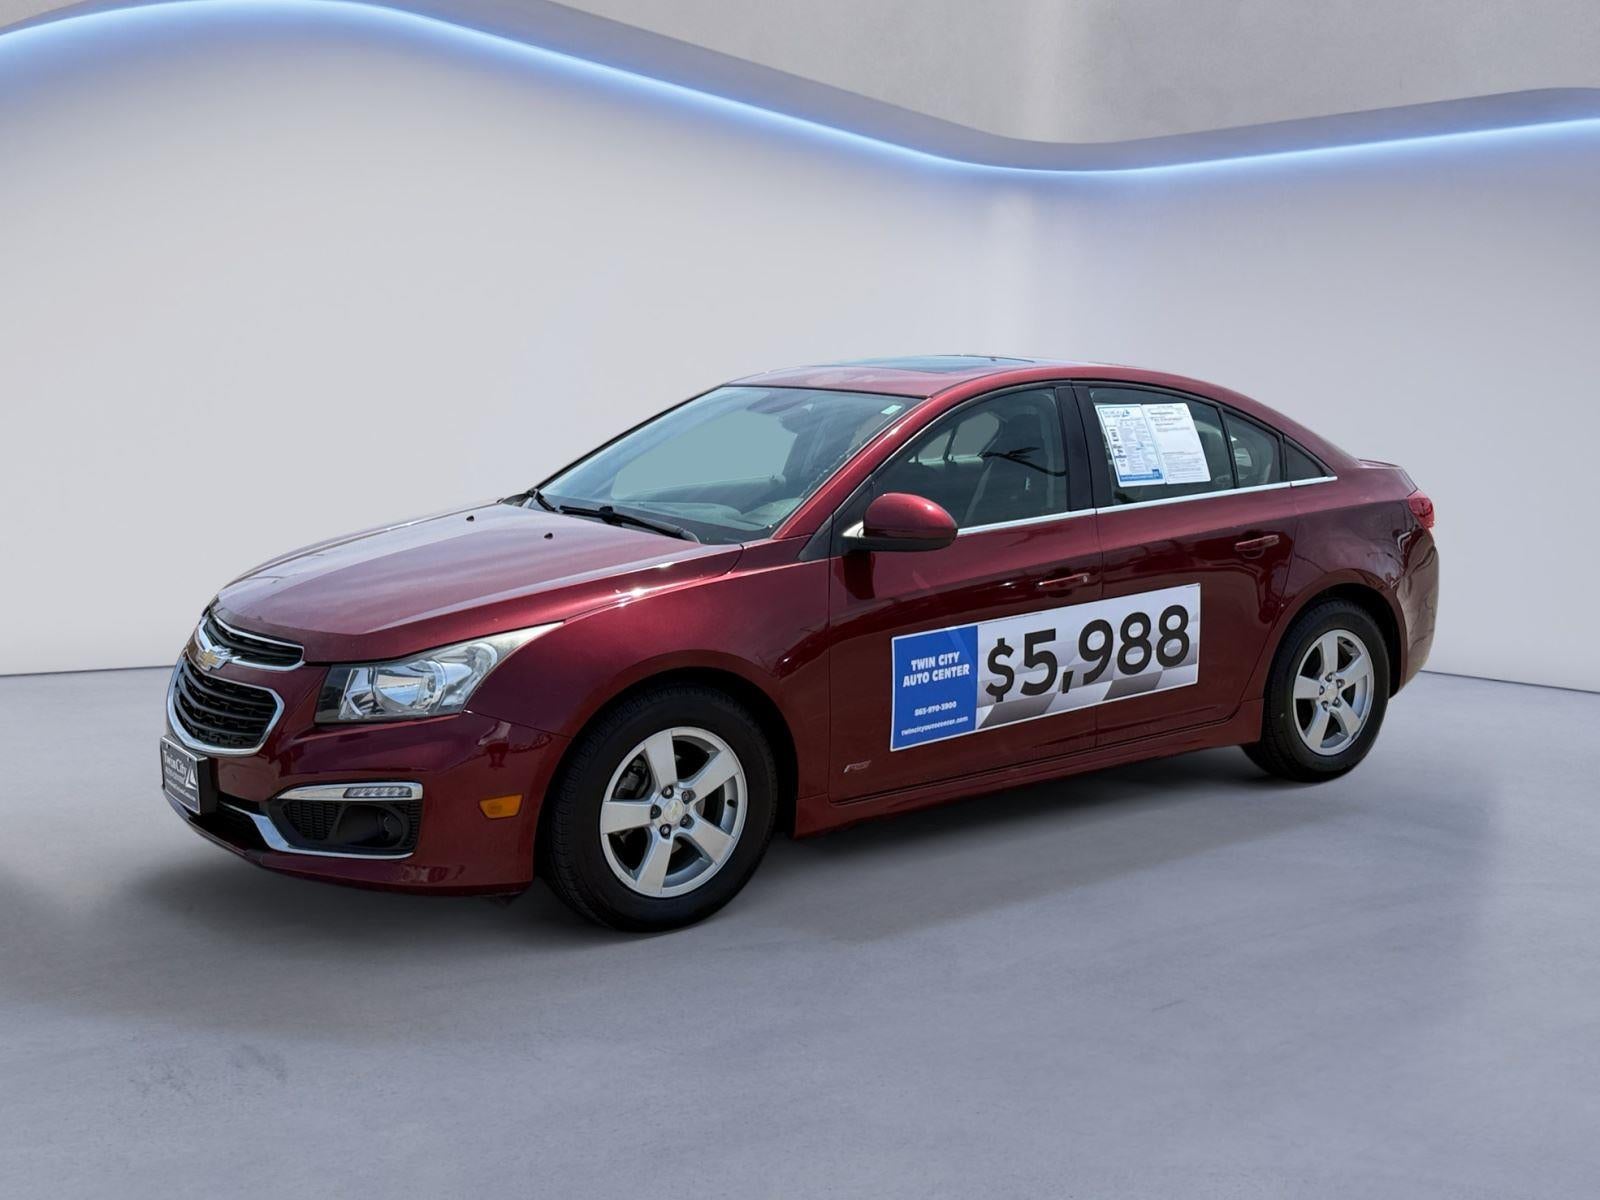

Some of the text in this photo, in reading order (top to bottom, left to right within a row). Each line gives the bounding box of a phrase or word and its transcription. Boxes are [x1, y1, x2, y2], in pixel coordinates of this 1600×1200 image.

[911, 651, 960, 671] TWIN CITY
[985, 604, 1190, 703] $5,988
[902, 663, 970, 688] AUTO CENTER
